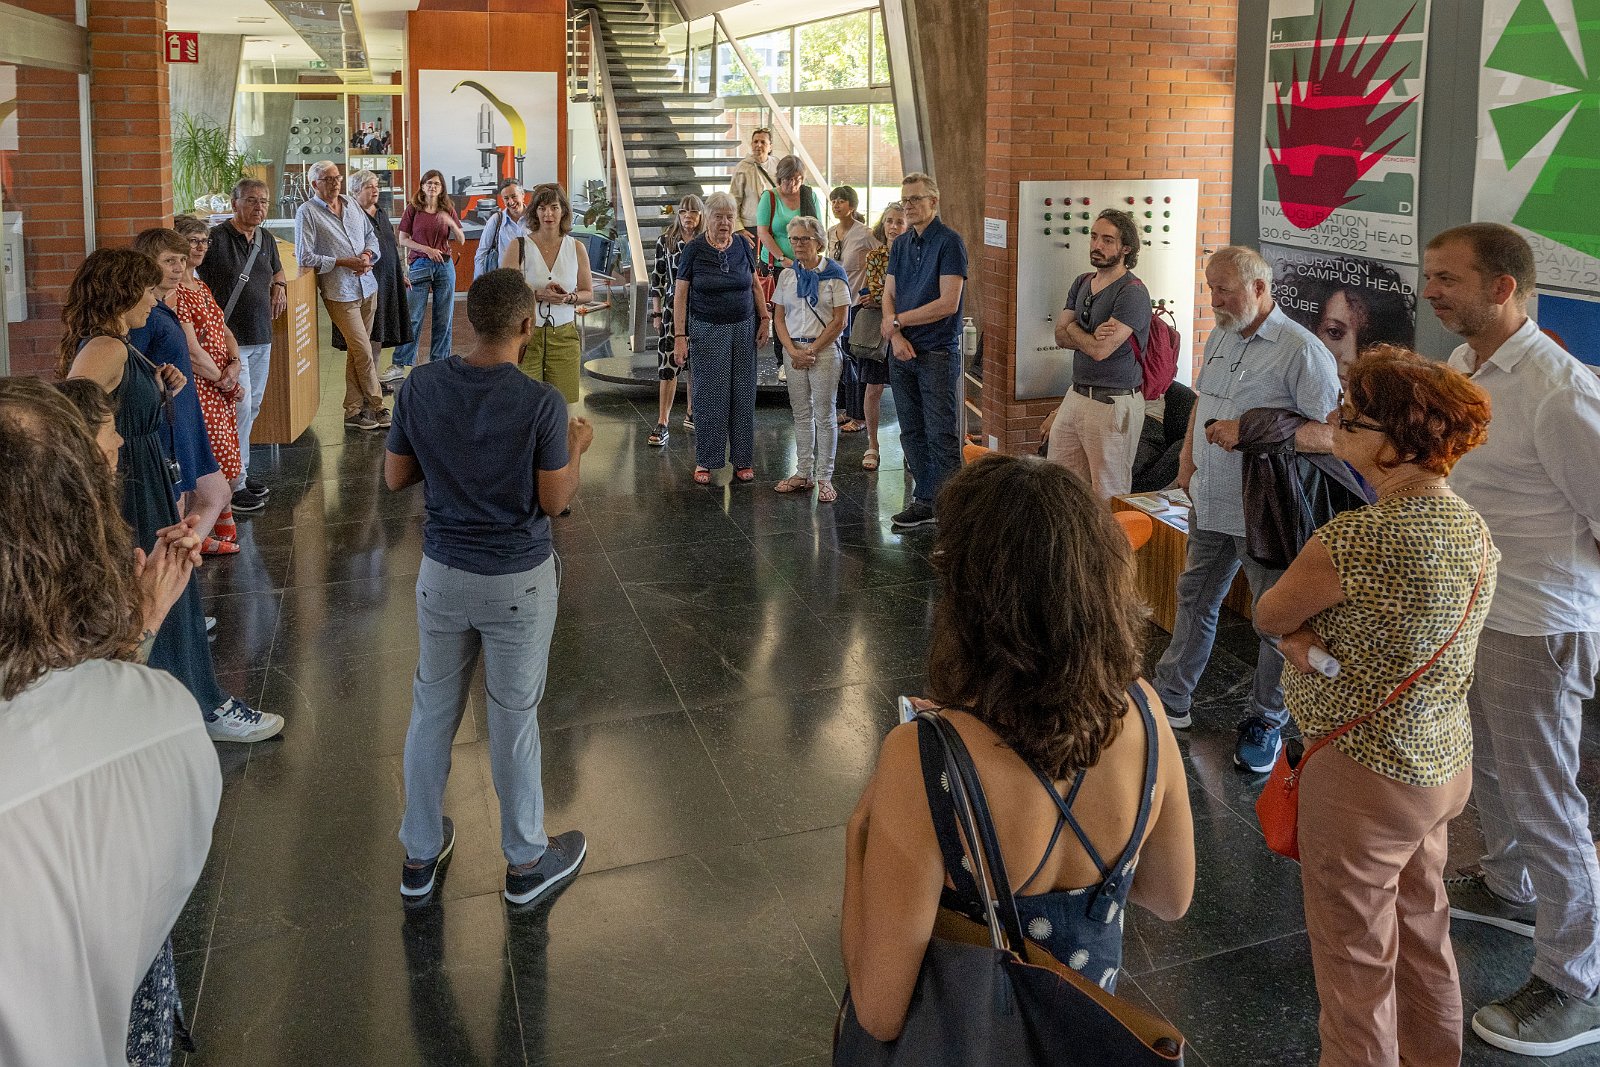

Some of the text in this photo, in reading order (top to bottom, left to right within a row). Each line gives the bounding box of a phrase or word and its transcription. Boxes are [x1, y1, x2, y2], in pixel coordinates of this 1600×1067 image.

[1272, 31, 1282, 40] H
[1313, 84, 1322, 94] E
[1353, 137, 1363, 147] A
[1399, 202, 1411, 212] D
[1262, 206, 1368, 227] INAUGURATION
[1300, 221, 1412, 245] CAMPUS HEAD
[1263, 248, 1369, 276] INAUGURATION
[1297, 265, 1414, 295] CAMPUS HEAD
[1280, 296, 1319, 314] CUBE
